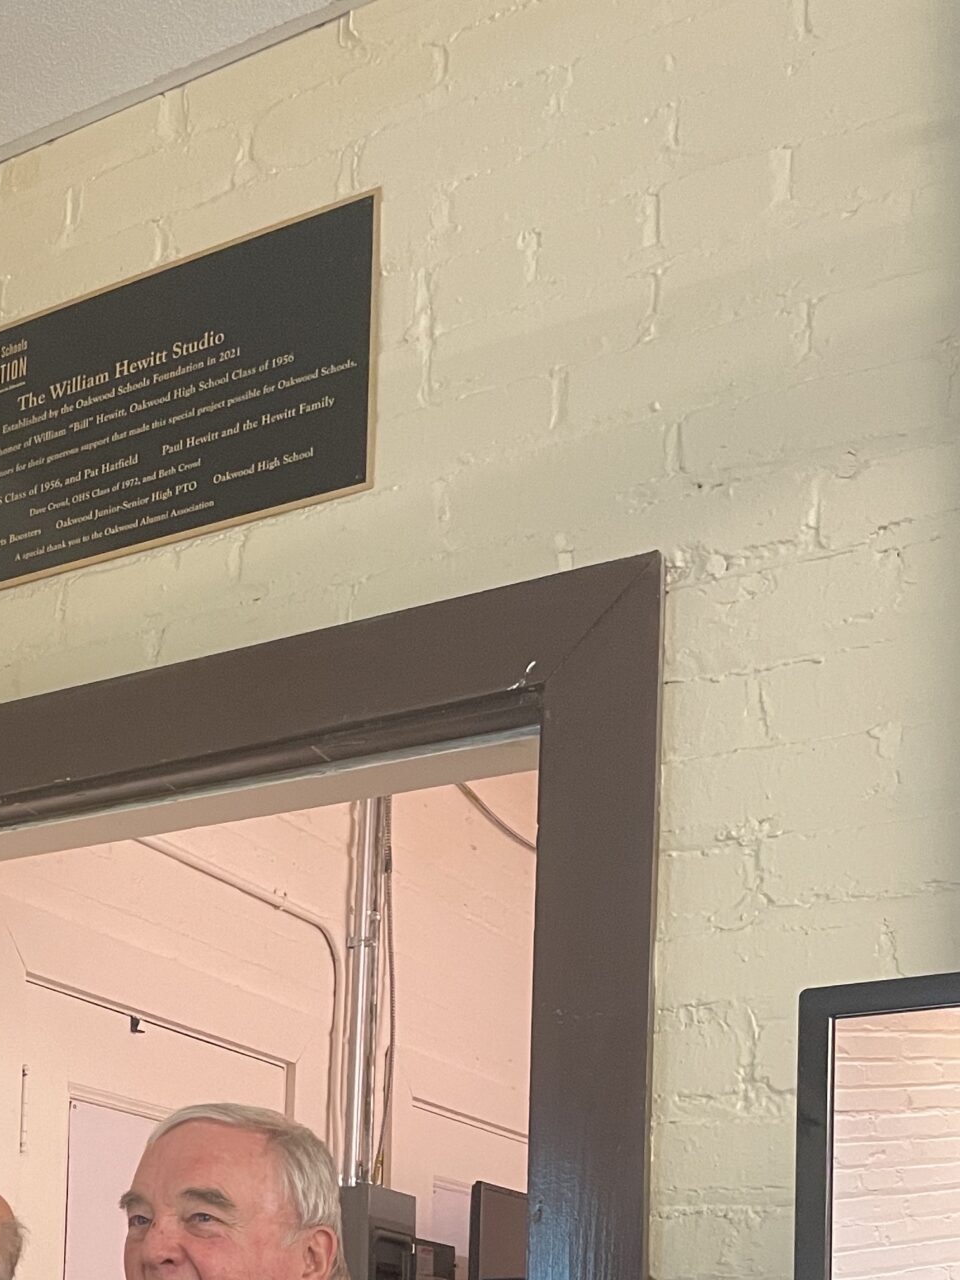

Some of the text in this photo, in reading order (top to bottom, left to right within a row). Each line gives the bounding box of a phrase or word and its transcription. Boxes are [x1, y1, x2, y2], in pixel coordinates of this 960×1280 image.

[2, 347, 241, 434] Established by the Oakwood Schools Foundation in 2021
[18, 392, 45, 411] The
[49, 371, 109, 397] William
[115, 350, 168, 378] Hewitt
[172, 330, 225, 358] Studio
[23, 438, 32, 447] of
[33, 428, 66, 445] William
[96, 409, 127, 424] Hewitt,
[130, 391, 171, 413] Oakwood
[174, 385, 196, 399] High
[199, 374, 229, 391] School
[232, 367, 256, 380] Class
[259, 361, 269, 371] of
[272, 353, 295, 368] 1956
[16, 463, 26, 472] for
[28, 457, 45, 469] their
[46, 448, 79, 464] generous
[81, 440, 109, 456] support
[111, 434, 127, 442] that
[129, 424, 150, 437] made
[151, 416, 166, 428] this
[168, 408, 195, 424] special
[197, 401, 225, 416] project
[227, 389, 261, 407] possible
[263, 385, 275, 394] for
[278, 370, 318, 389] Oakwood
[321, 359, 357, 376] Schools.
[162, 396, 335, 455] Paul Hewitt and the Hewitt Family
[5, 491, 26, 504] Class
[29, 486, 37, 495] of
[40, 479, 62, 493] 1956,
[65, 472, 81, 484] and
[84, 468, 99, 479] Pat
[102, 454, 138, 473] Hatfield
[29, 506, 46, 517] Dave
[72, 492, 90, 504] OHS
[92, 487, 110, 498] Class
[112, 482, 120, 492] of
[121, 477, 140, 489] 1972,
[142, 472, 157, 482] and
[158, 466, 176, 478] Beth
[213, 447, 314, 484] Oakwood High School
[14, 552, 21, 561] A
[22, 546, 45, 560] special
[46, 540, 66, 554] thank
[68, 537, 81, 548] you
[92, 530, 103, 539] the
[104, 518, 138, 536] Oakwood
[140, 511, 169, 527] Alumni
[171, 499, 214, 517] Association
[56, 481, 198, 529] Oakwood Junior-Senior High PTO
[9, 529, 41, 543] Boosters
